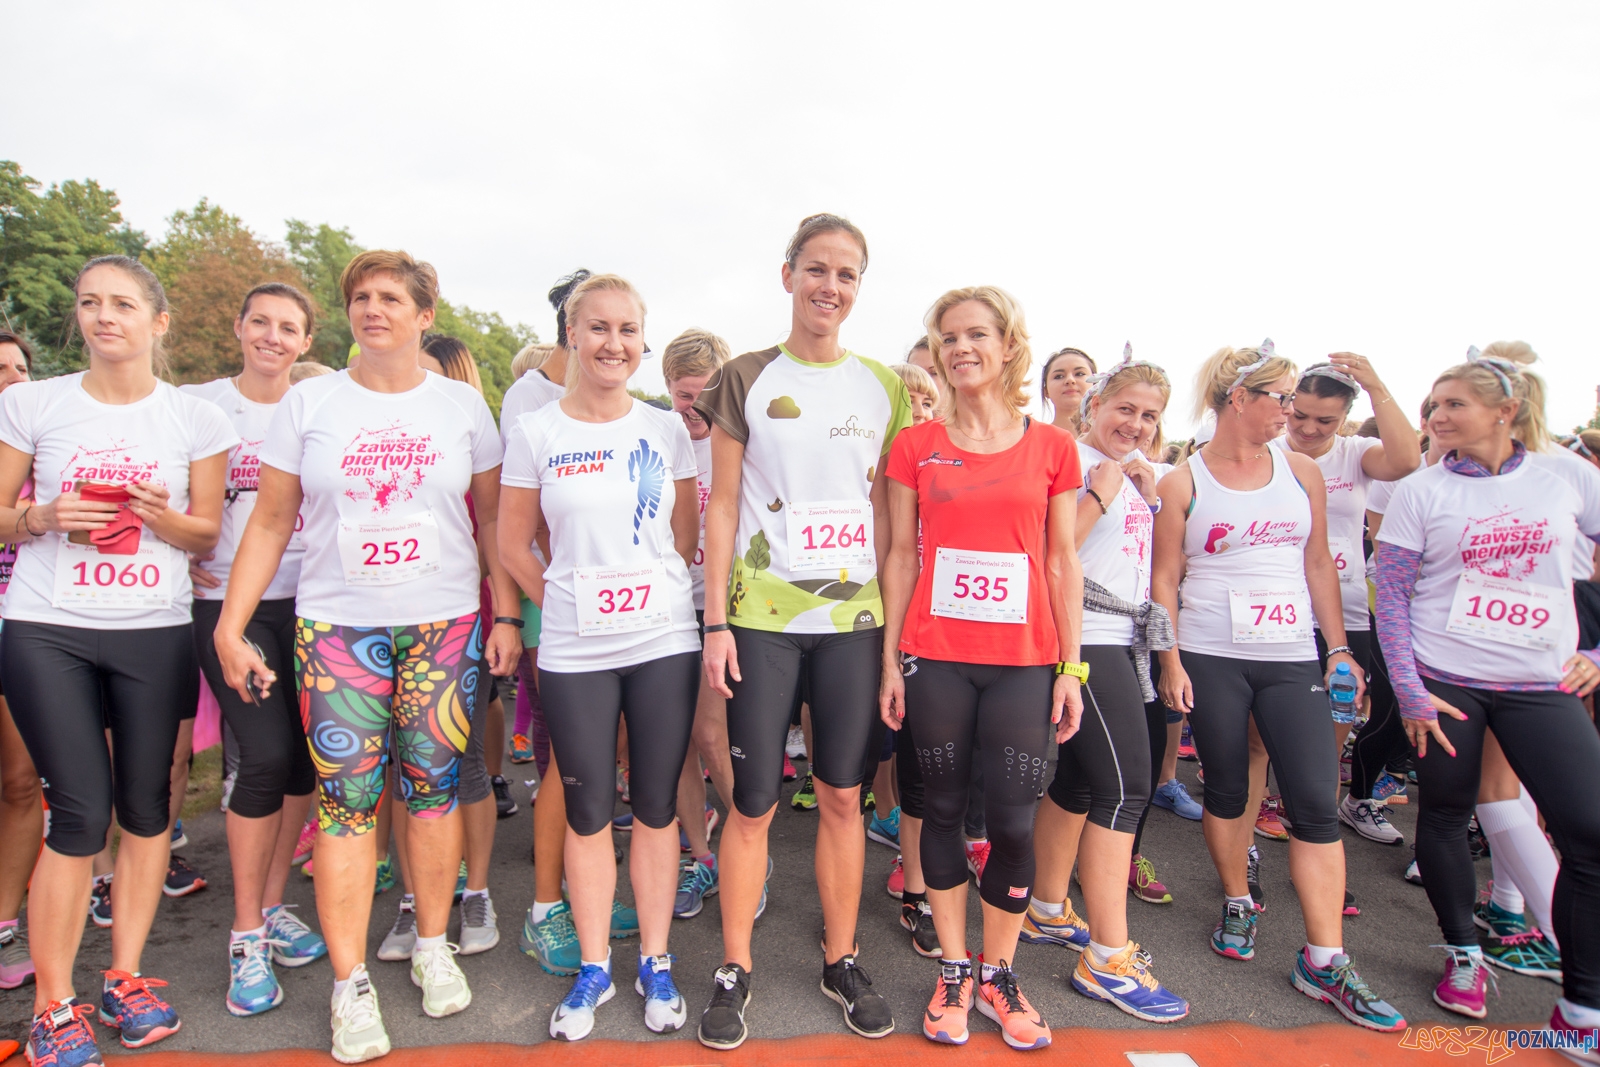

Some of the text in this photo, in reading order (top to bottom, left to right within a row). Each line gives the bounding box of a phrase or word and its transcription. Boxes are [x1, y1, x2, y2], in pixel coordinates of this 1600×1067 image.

[829, 415, 875, 439] parkrun
[357, 443, 427, 453] zawsze
[117, 463, 143, 471] KOBIET
[548, 449, 614, 468] HERNIK
[73, 466, 152, 482] zawsze
[345, 467, 376, 477] 2016
[555, 462, 604, 478] TEAM
[801, 523, 867, 550] 1264
[1241, 520, 1298, 540] Mamy
[1241, 532, 1304, 547] Biegamy
[1470, 529, 1544, 546] zawsze
[361, 537, 420, 566] 252
[72, 561, 160, 588] 1060
[953, 574, 1008, 602] 535
[597, 584, 651, 614] 327
[1250, 603, 1297, 626] 743
[1466, 595, 1550, 629] 1089
